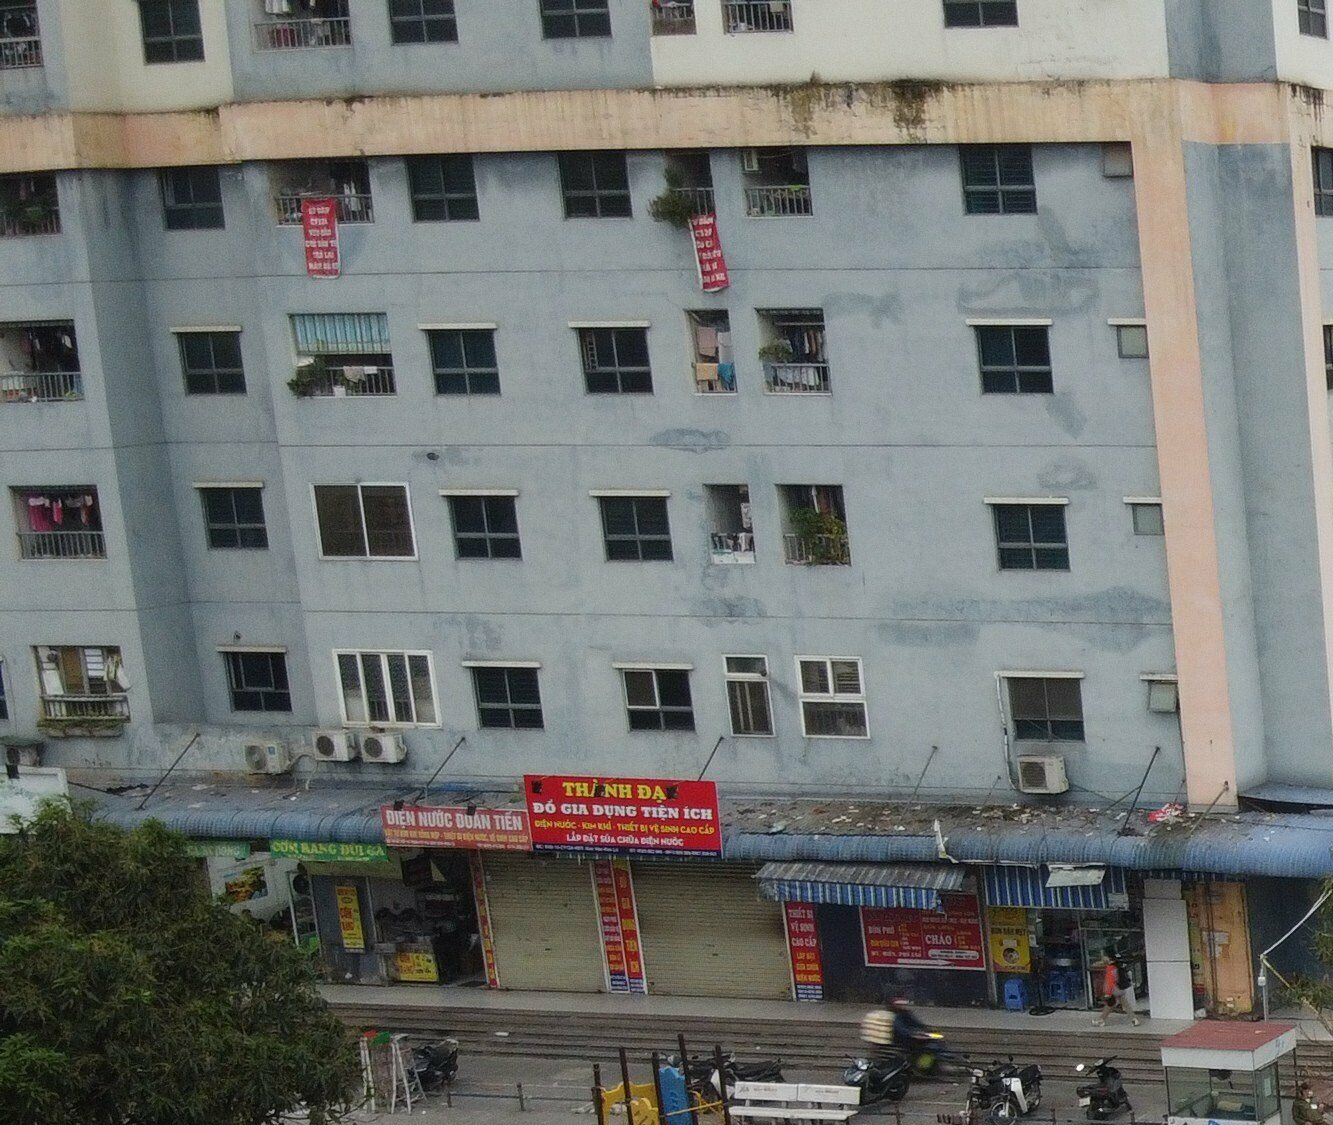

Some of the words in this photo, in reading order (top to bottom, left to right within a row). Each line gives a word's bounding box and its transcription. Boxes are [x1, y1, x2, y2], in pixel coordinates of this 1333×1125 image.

[637, 784, 675, 803] ĐẠ
[418, 809, 453, 828] NƯỚC
[533, 799, 556, 814] ĐỒ
[561, 803, 589, 816] GIA
[592, 804, 637, 821] DỤNG
[641, 805, 679, 821] TIỆN
[684, 805, 713, 820] ÍCH
[680, 826, 698, 835] CAO
[925, 930, 953, 945] CHÁO
